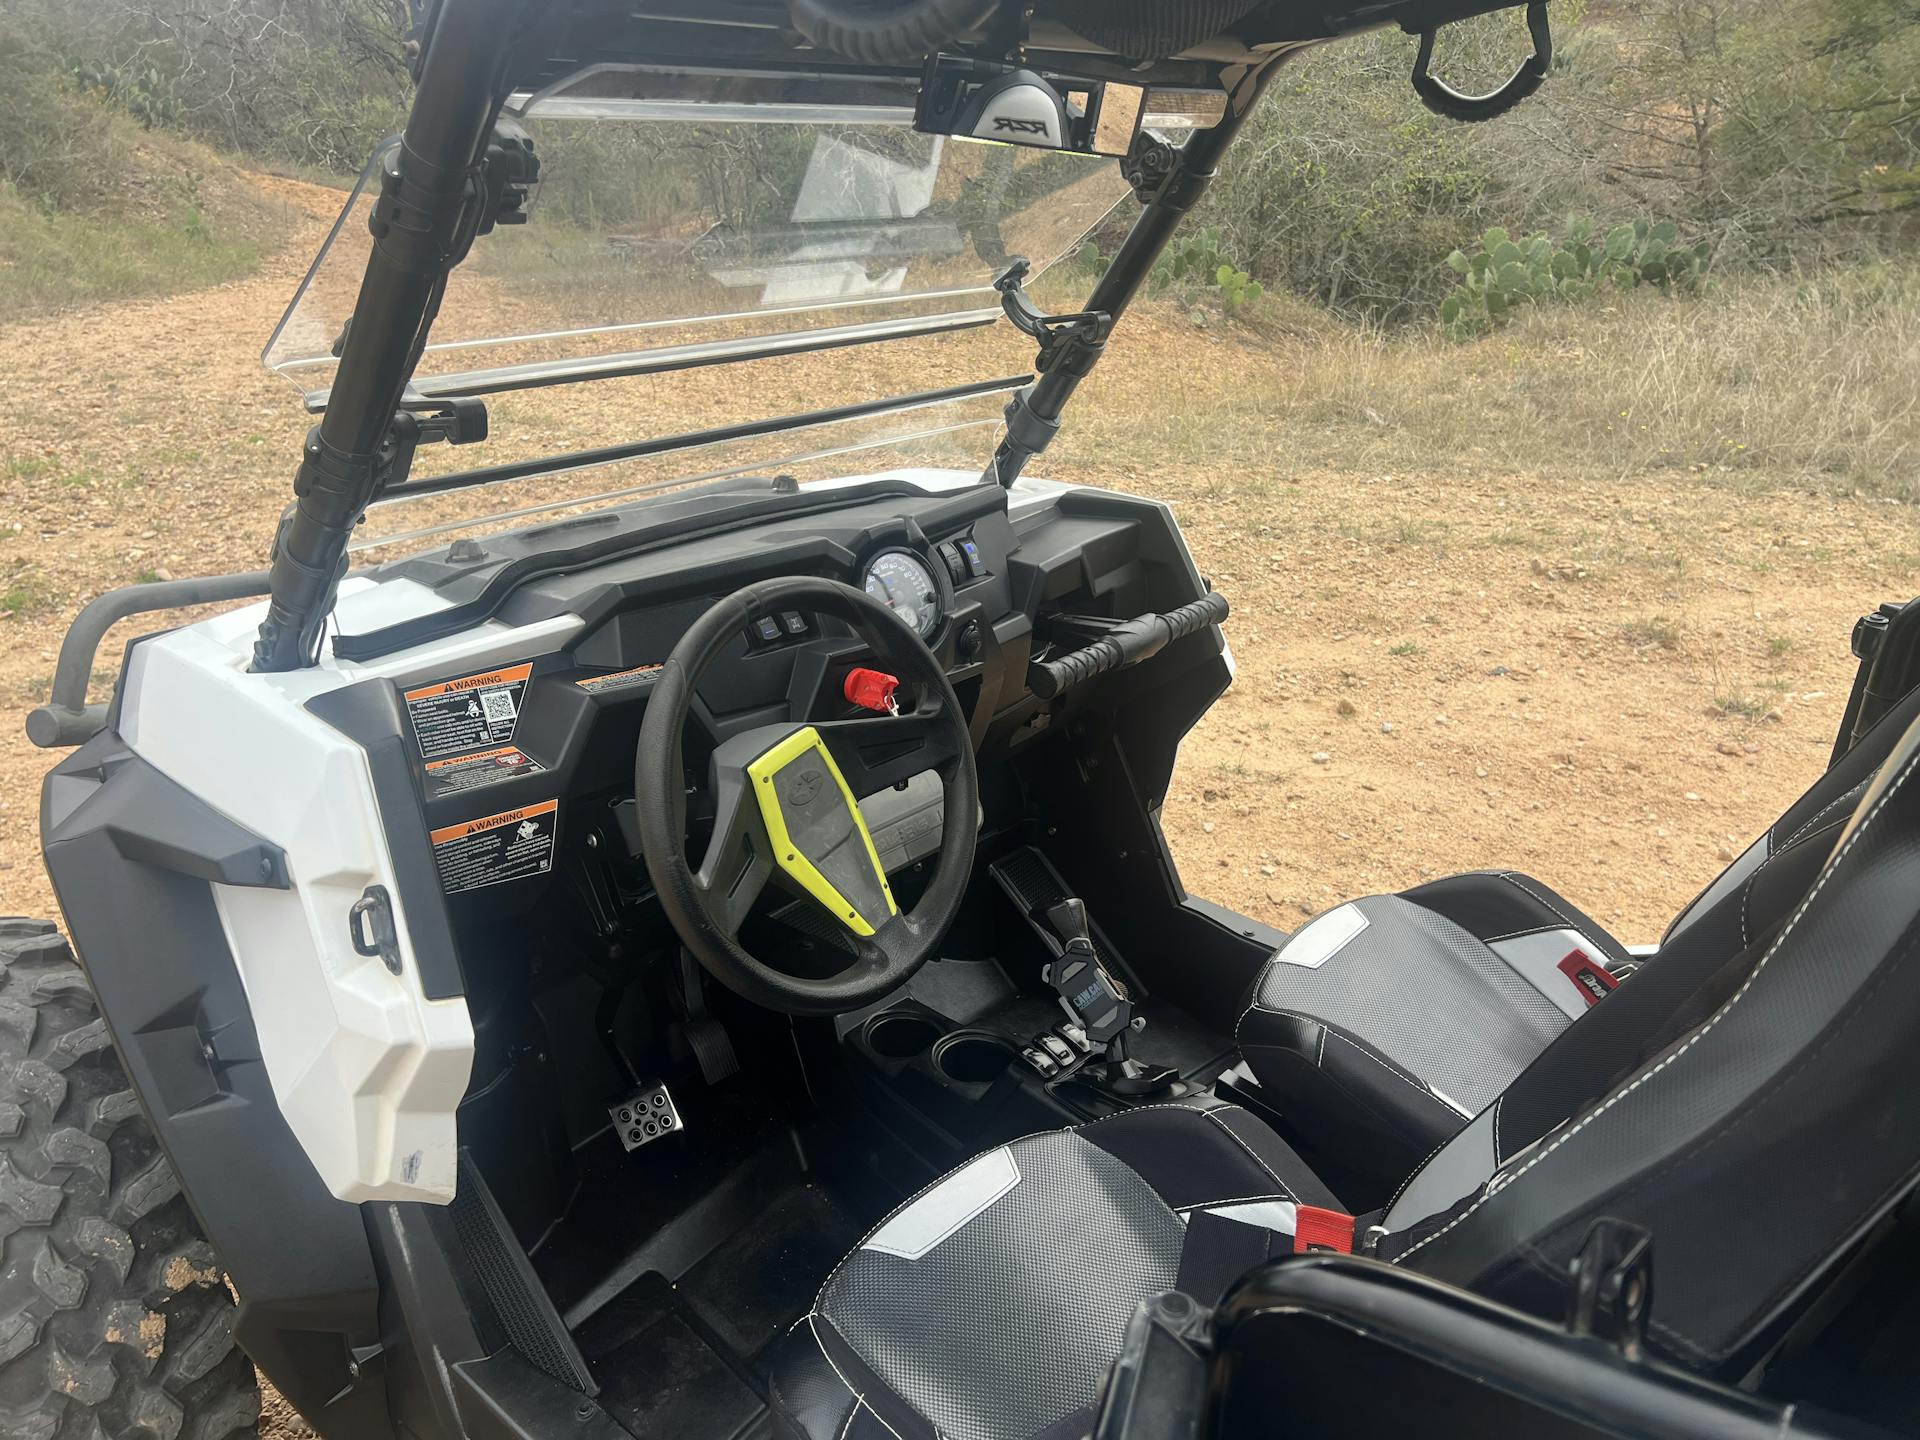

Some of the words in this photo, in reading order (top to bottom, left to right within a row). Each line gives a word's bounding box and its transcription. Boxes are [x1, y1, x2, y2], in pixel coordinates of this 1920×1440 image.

[454, 675, 502, 691] WARNING
[453, 751, 502, 763] WARNING
[476, 811, 524, 830] WARNING
